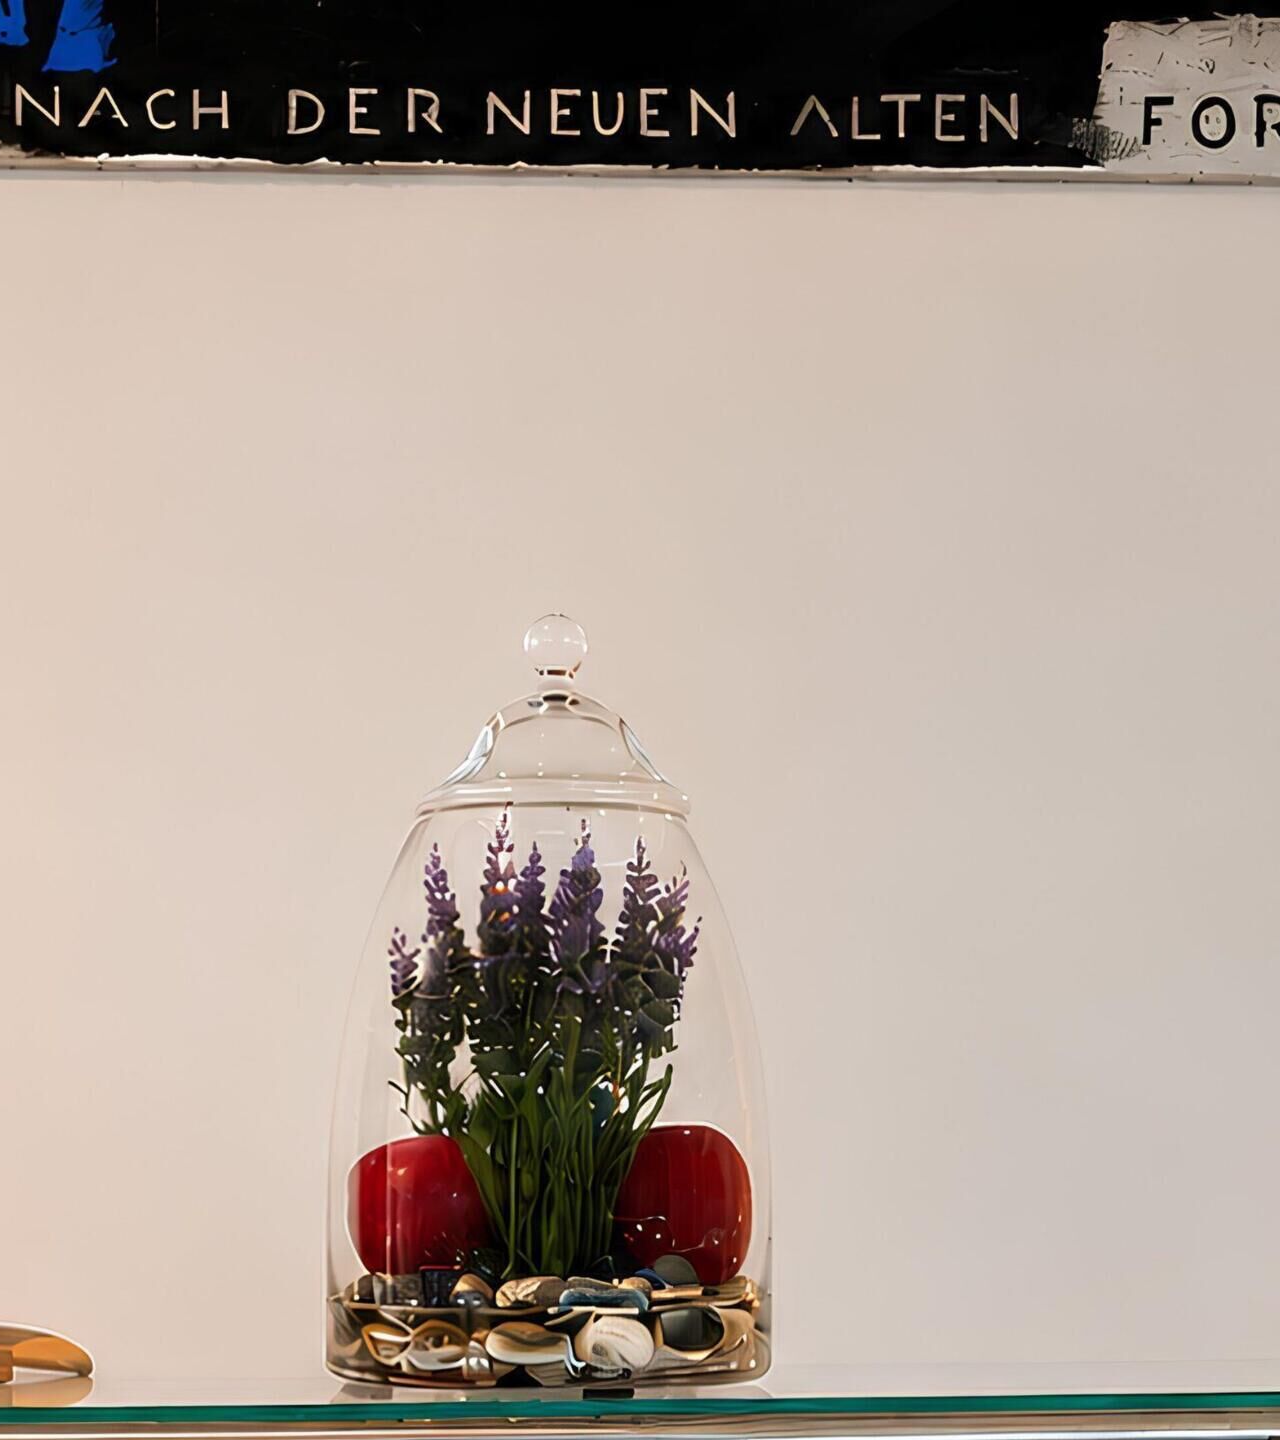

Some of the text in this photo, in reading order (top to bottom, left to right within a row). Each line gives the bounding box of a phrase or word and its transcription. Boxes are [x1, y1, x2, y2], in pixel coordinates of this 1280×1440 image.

[14, 82, 231, 131] NACH
[286, 88, 444, 136] DER
[485, 88, 738, 139] NEUEN
[789, 92, 1020, 143] ALTEN
